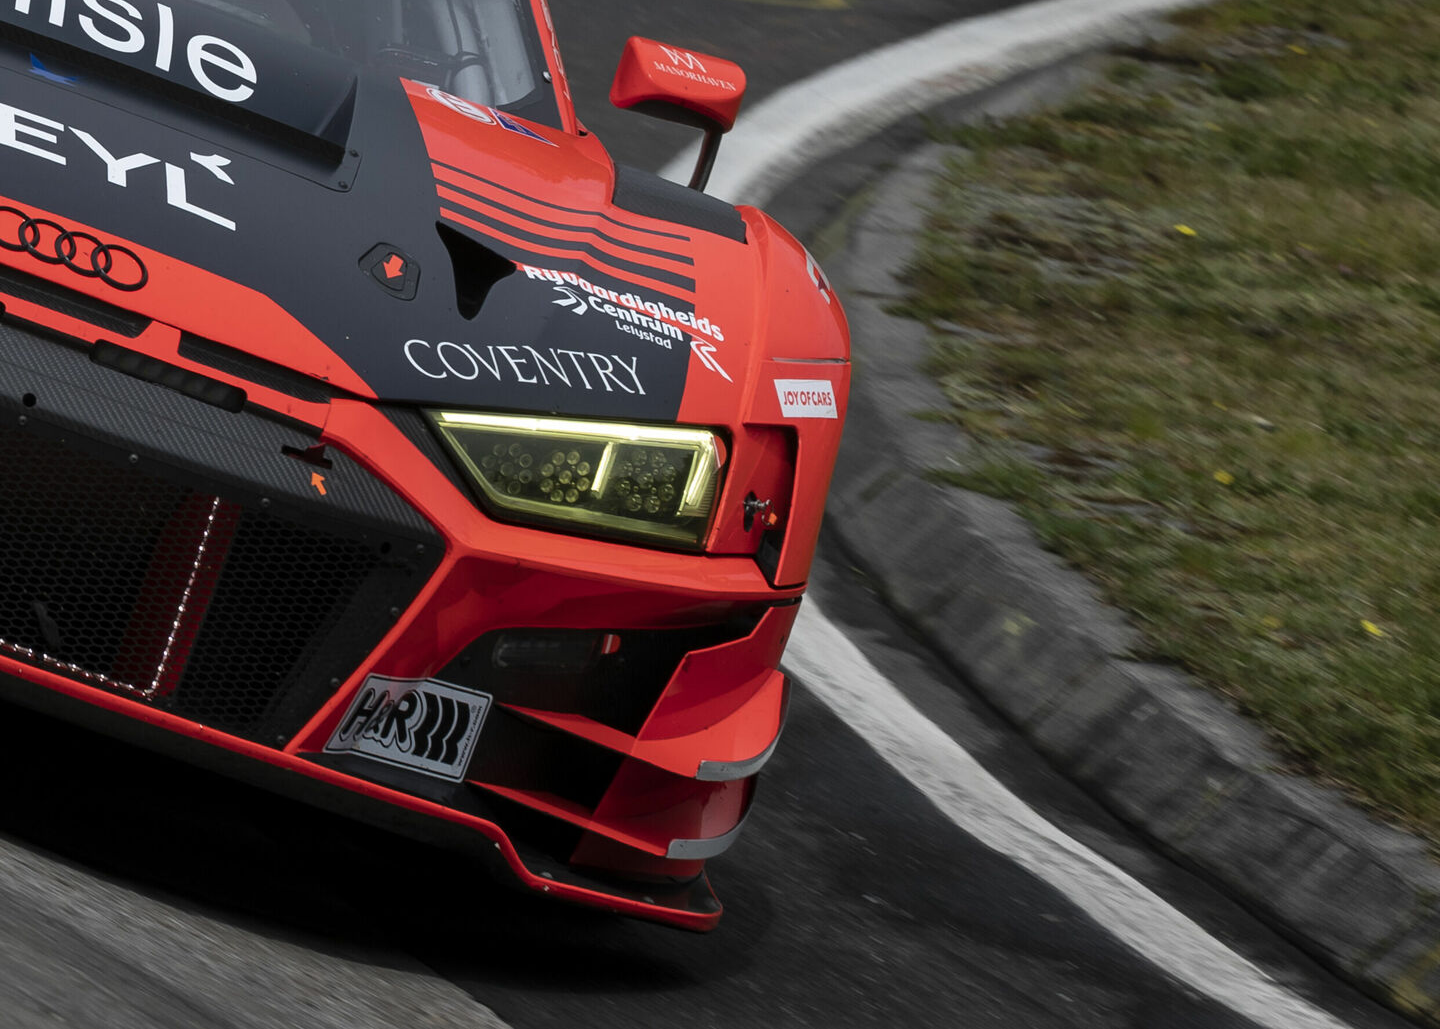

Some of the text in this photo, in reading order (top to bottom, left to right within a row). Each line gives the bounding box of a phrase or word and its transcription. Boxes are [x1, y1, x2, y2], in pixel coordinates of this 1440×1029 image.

[653, 60, 737, 92] MANORHAVEN
[522, 264, 725, 342] Rijvaardigheids
[587, 295, 684, 342] Centrum
[615, 320, 673, 350] Lelystad
[403, 339, 647, 396] COVENTRY
[340, 688, 418, 744] H&R
